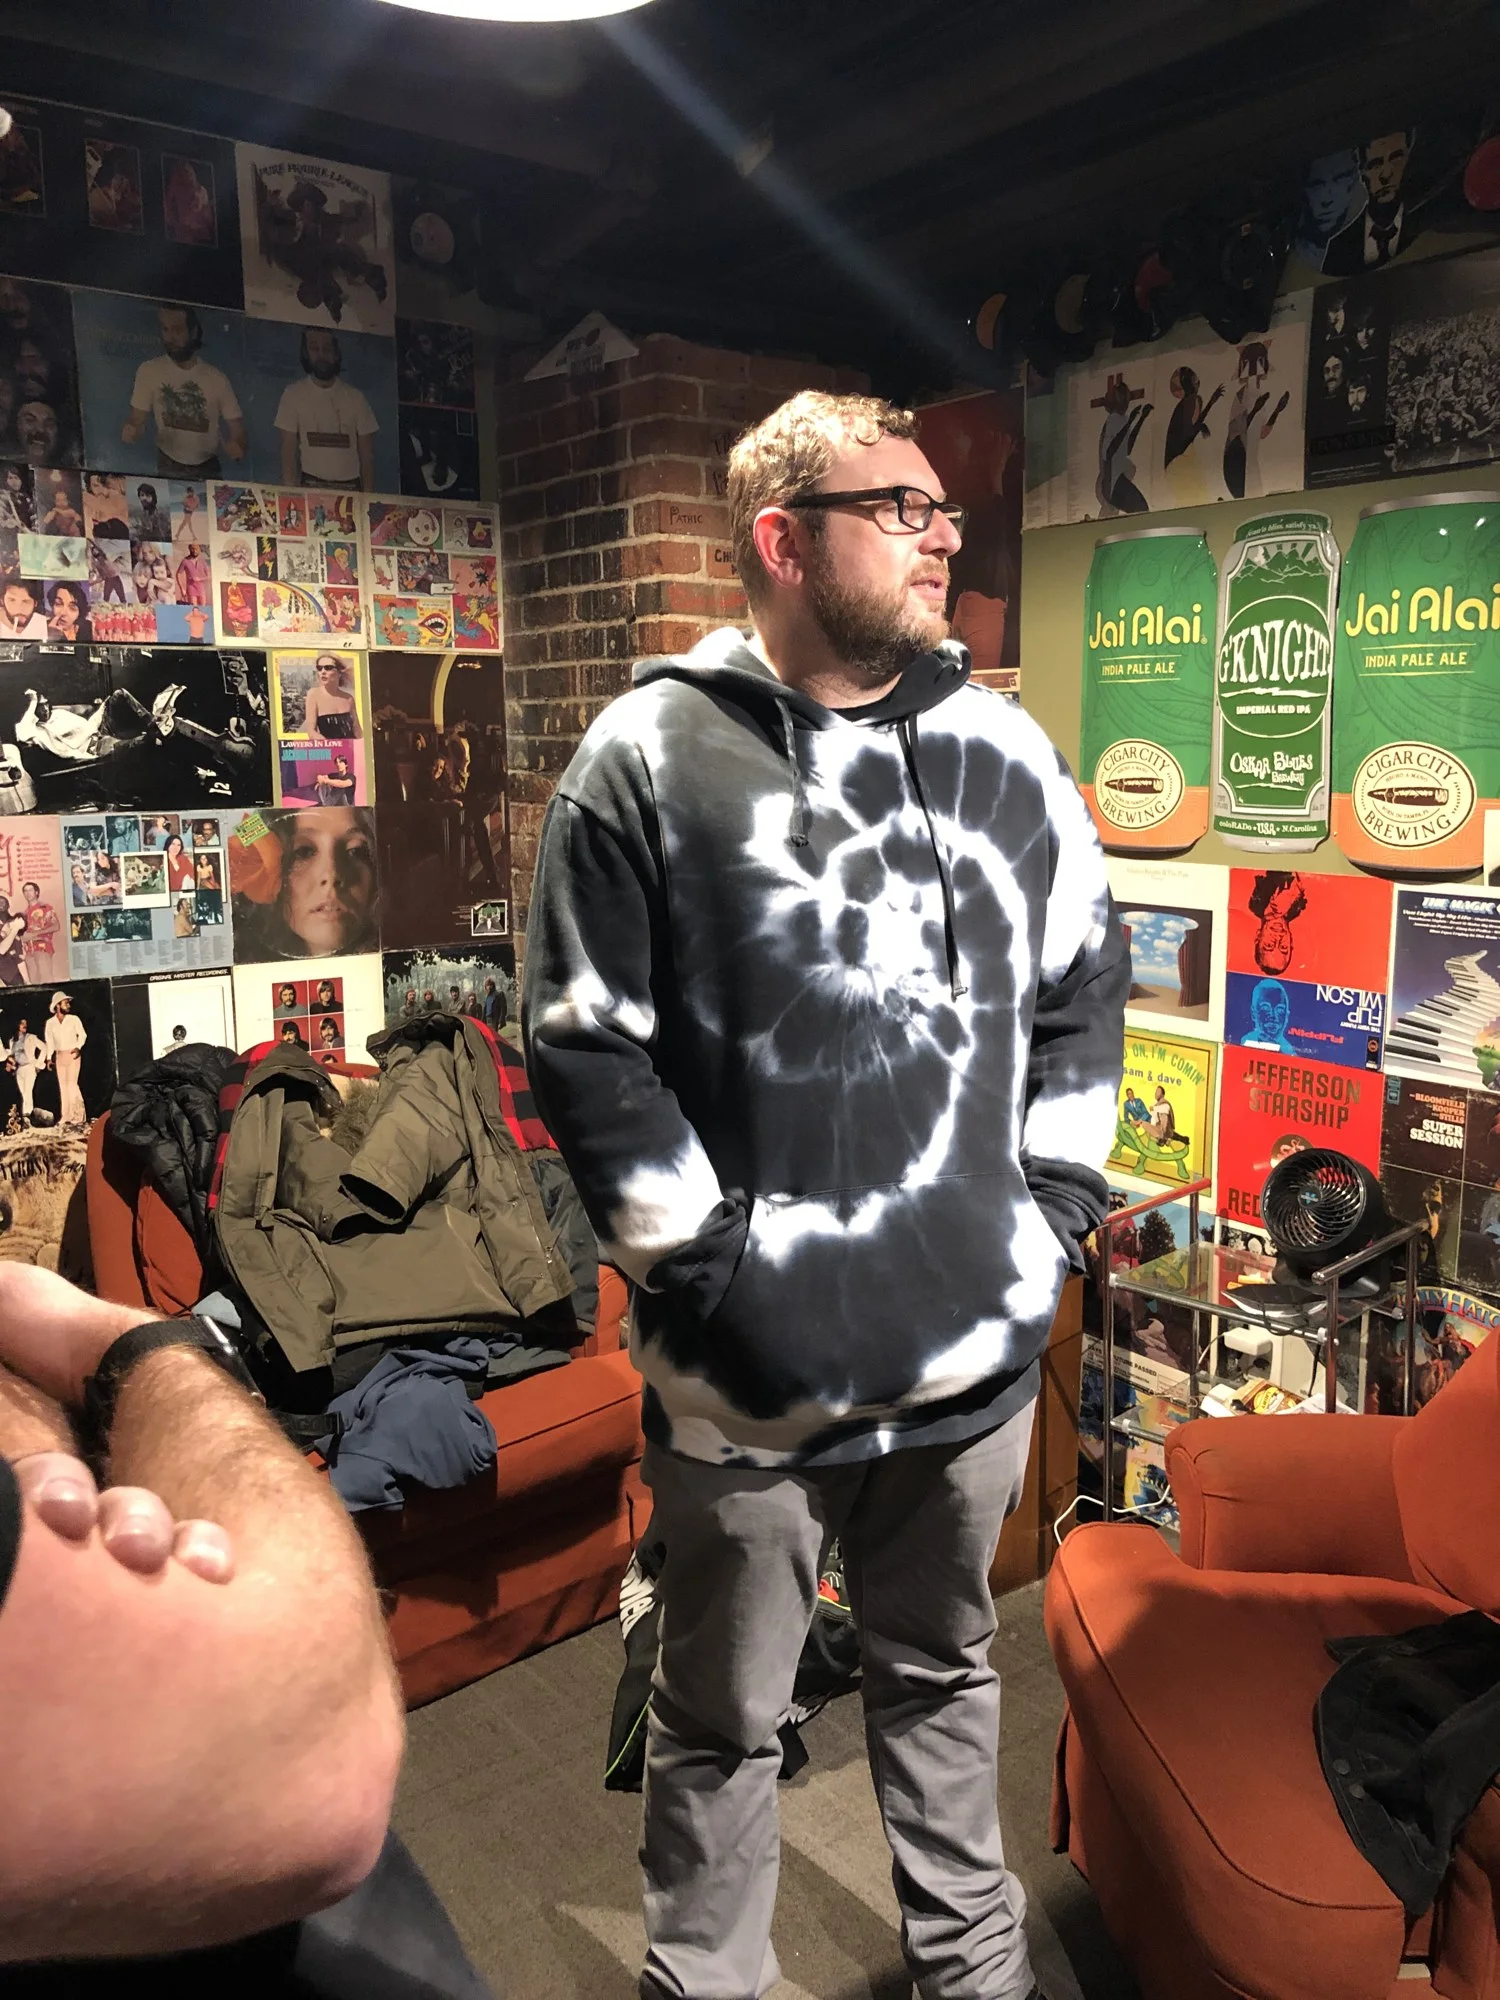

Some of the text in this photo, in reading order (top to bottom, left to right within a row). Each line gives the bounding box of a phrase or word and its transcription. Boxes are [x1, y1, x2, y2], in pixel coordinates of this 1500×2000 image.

[1345, 583, 1500, 637] Jai Alai
[1089, 603, 1202, 649] Jai Alai
[1102, 662, 1175, 676] INDIA PALE ALE
[1365, 652, 1467, 668] INDIA PALE ALE
[1236, 704, 1311, 715] IMPERIAL RED IPA
[1103, 746, 1170, 772] CIGAR CITY
[1366, 750, 1458, 780] CIGAR CITY
[1102, 798, 1166, 824] BREWING
[1256, 823, 1276, 836] USA
[1364, 810, 1452, 840] BREWING
[1316, 984, 1382, 1010] WILSON
[1347, 1007, 1382, 1027] FLIP
[1151, 1044, 1167, 1062] I'M
[1170, 1054, 1206, 1085] COMIN'
[1147, 1070, 1153, 1082] &
[1157, 1073, 1182, 1086] dave
[1243, 1060, 1361, 1105] JEFFERSON
[1249, 1087, 1349, 1129] STARSHIP
[1415, 1093, 1466, 1109] BLOOMFIELD
[1432, 1104, 1465, 1117] KOOPER
[1422, 1119, 1463, 1138] SUPER
[1439, 1112, 1465, 1124] STILLS
[1410, 1128, 1463, 1149] SESSION
[1228, 1188, 1261, 1218] RED
[1134, 1363, 1157, 1377] PASSED
